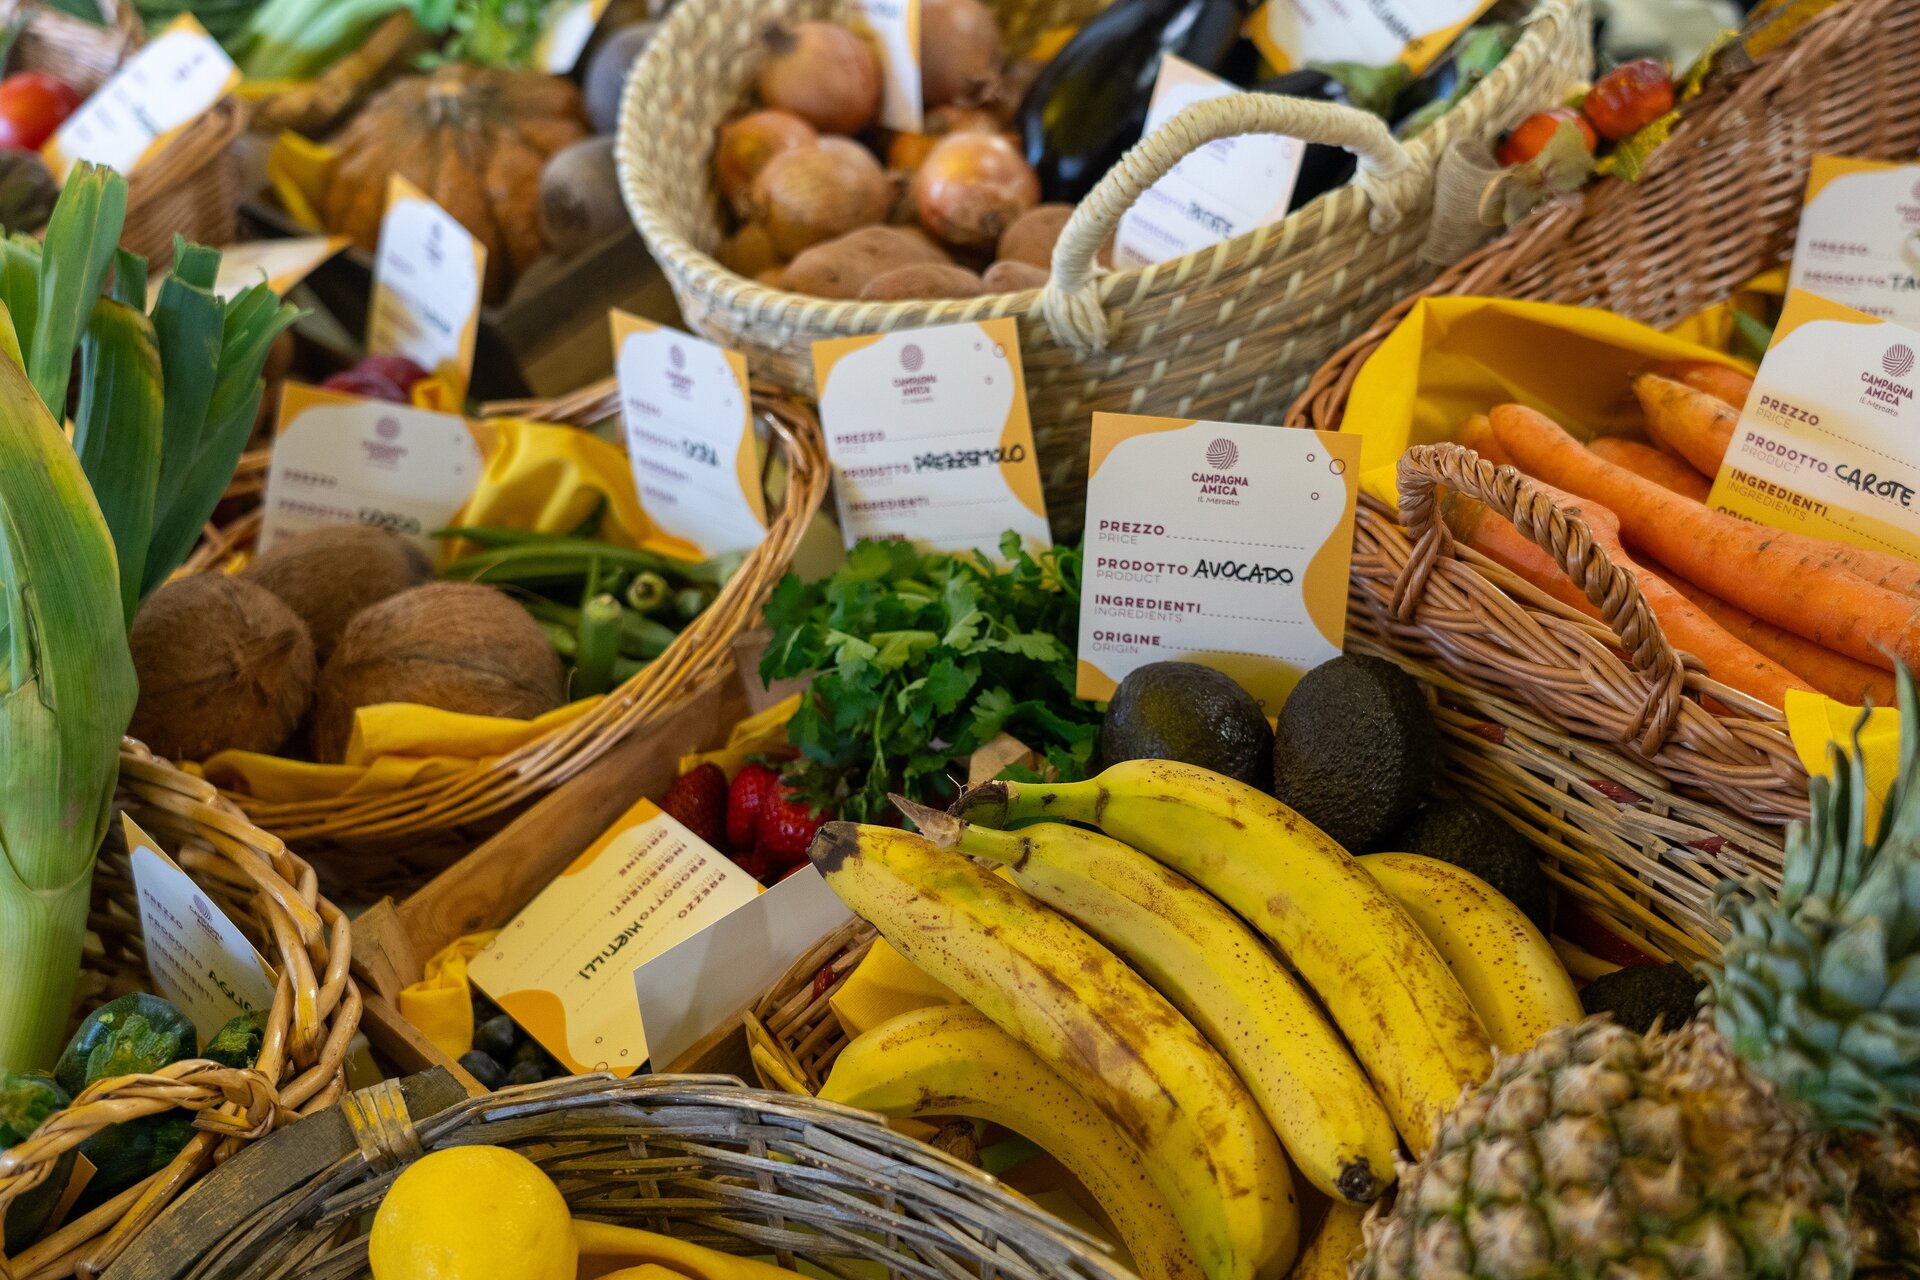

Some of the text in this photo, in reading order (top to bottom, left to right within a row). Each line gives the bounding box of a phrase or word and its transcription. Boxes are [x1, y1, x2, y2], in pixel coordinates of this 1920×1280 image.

[1861, 372, 1914, 400] CAMPAGNA
[1865, 387, 1900, 407] AMICA
[1756, 408, 1792, 430] PRICE
[1760, 395, 1819, 426] PREZZO
[1867, 399, 1898, 417] Mercato
[835, 431, 886, 445] PREZZO
[1741, 444, 1801, 475] PRODUCT
[1746, 432, 1915, 507] PRODOTTO CAROTE
[1191, 473, 1249, 487] CAMPAGNA
[1200, 485, 1238, 496] AMICA
[1206, 496, 1240, 506] Mercato
[1726, 480, 1807, 522] INGREDIENTS
[1731, 469, 1828, 518] INGREDIENTI
[1099, 532, 1138, 545] PRICE
[1100, 520, 1165, 536] PREZZO
[1096, 570, 1160, 585] PRODUCT
[1097, 558, 1293, 583] PRODOTTO AVOCADO
[1094, 607, 1183, 623] INGREDIENTS
[1095, 594, 1201, 614] INGREDIENTI
[1092, 630, 1161, 646] ORIGINE
[1092, 643, 1139, 655] ORIGIN
[618, 829, 668, 877] ORIGINE
[610, 843, 687, 916] INGREDIENTI
[678, 872, 727, 919] PREZZO
[144, 888, 183, 930] PREZZO
[578, 858, 707, 980] PRODOTTO MIRTILLI
[148, 912, 203, 969] PRODOTTO
[151, 937, 214, 1003] INGREDIENTI
